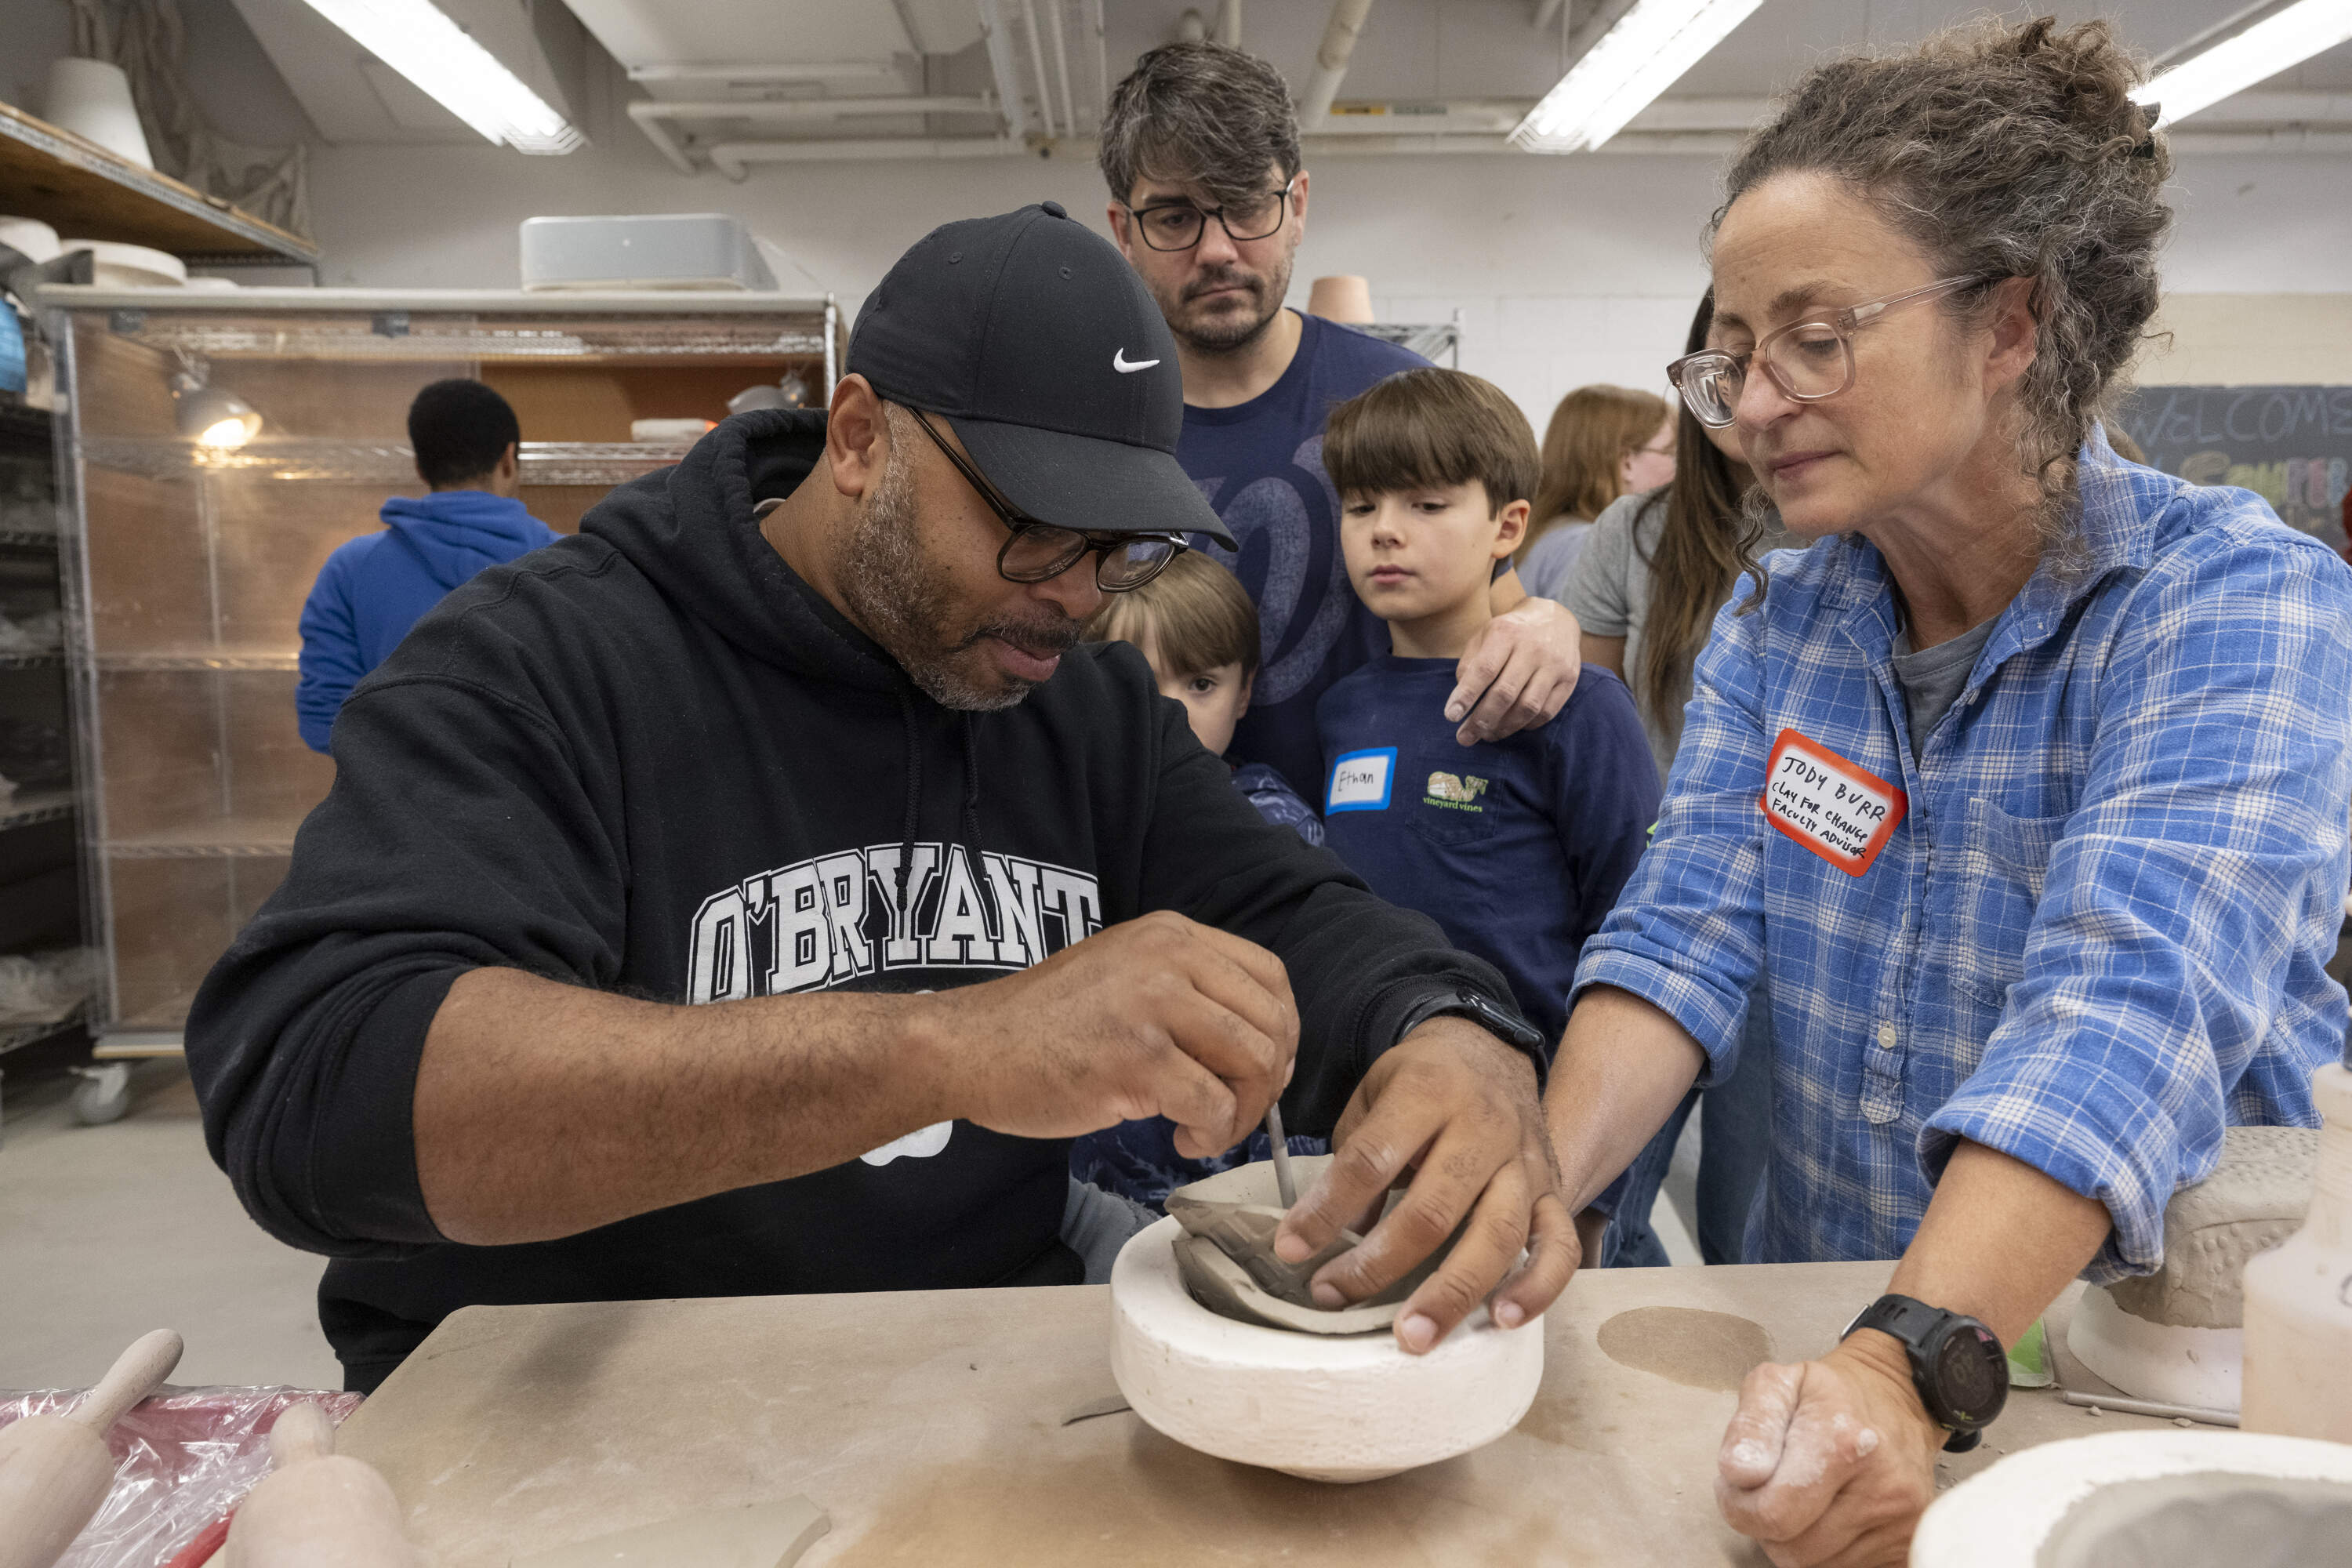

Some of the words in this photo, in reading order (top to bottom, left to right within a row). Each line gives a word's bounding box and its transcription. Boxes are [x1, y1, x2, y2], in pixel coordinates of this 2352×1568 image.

[1338, 771, 1374, 792] Ethan
[1772, 781, 1798, 803] CLAY
[1800, 797, 1820, 815] FOR
[1782, 757, 1828, 790] JODY
[1835, 783, 1886, 822] BURR
[1423, 797, 1458, 809] vineyard
[1459, 803, 1483, 813] vines
[1772, 797, 1817, 832] FACULTY
[687, 842, 1102, 1006] O'BRYANT
